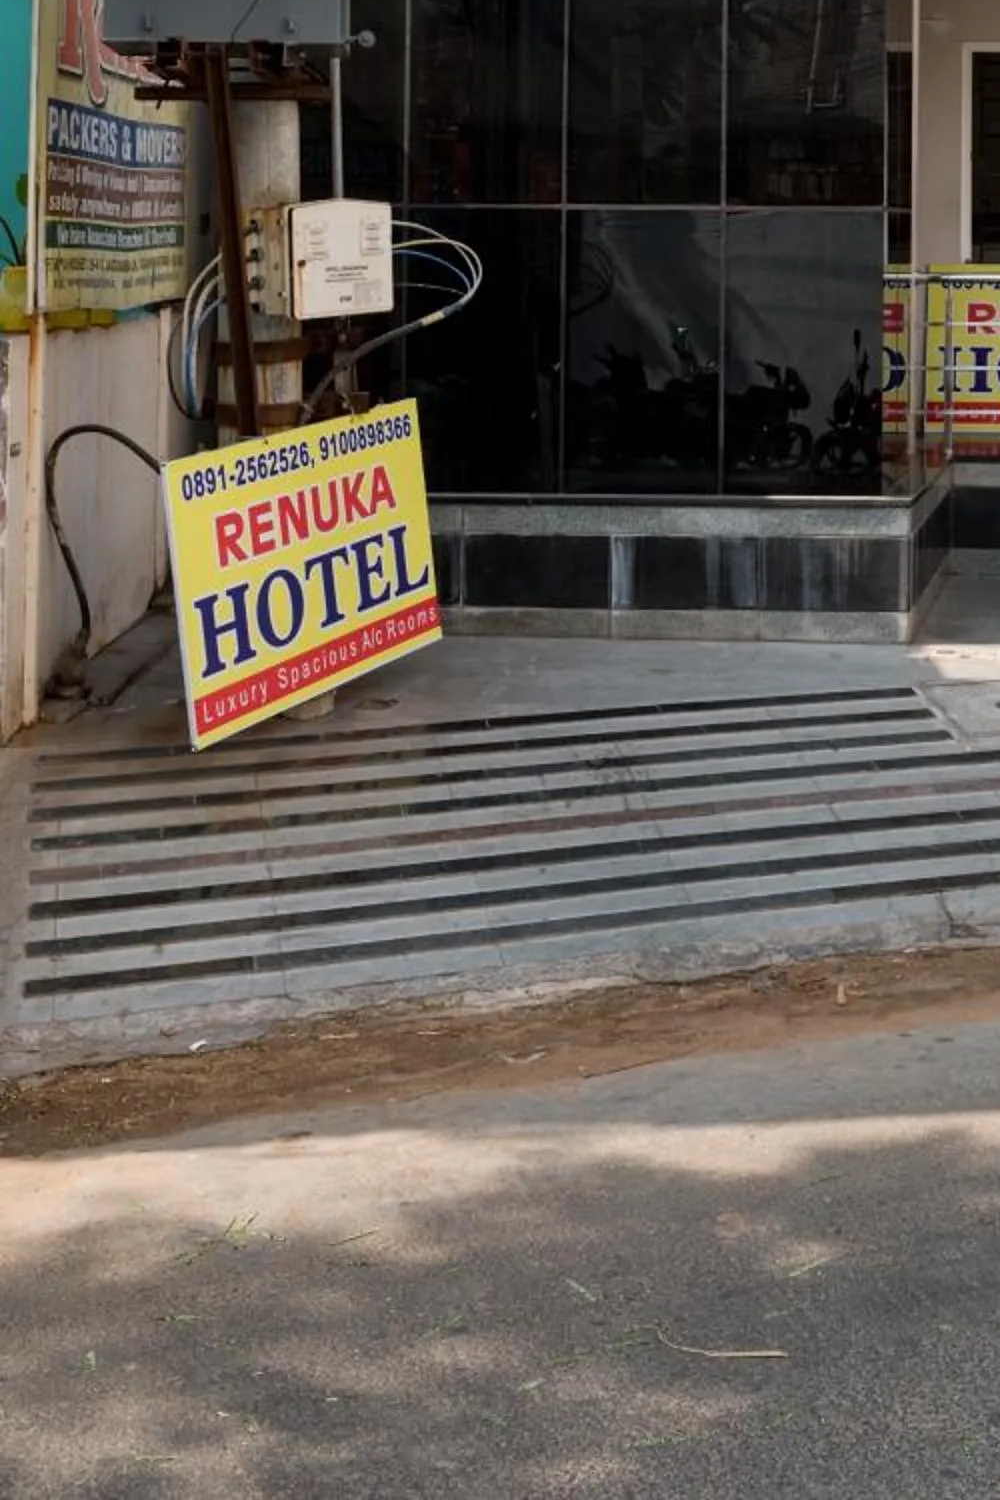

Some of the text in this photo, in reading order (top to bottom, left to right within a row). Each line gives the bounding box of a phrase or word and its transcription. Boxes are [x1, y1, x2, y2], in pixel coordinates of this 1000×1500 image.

[48, 105, 117, 158] PACKERS
[122, 125, 131, 160] &
[182, 414, 411, 501] 0891-2562526, 9100898366
[214, 465, 396, 568] RENUKA
[193, 524, 429, 679] HOTEL
[202, 608, 437, 723] Luxury Spacious A/c Rooms
